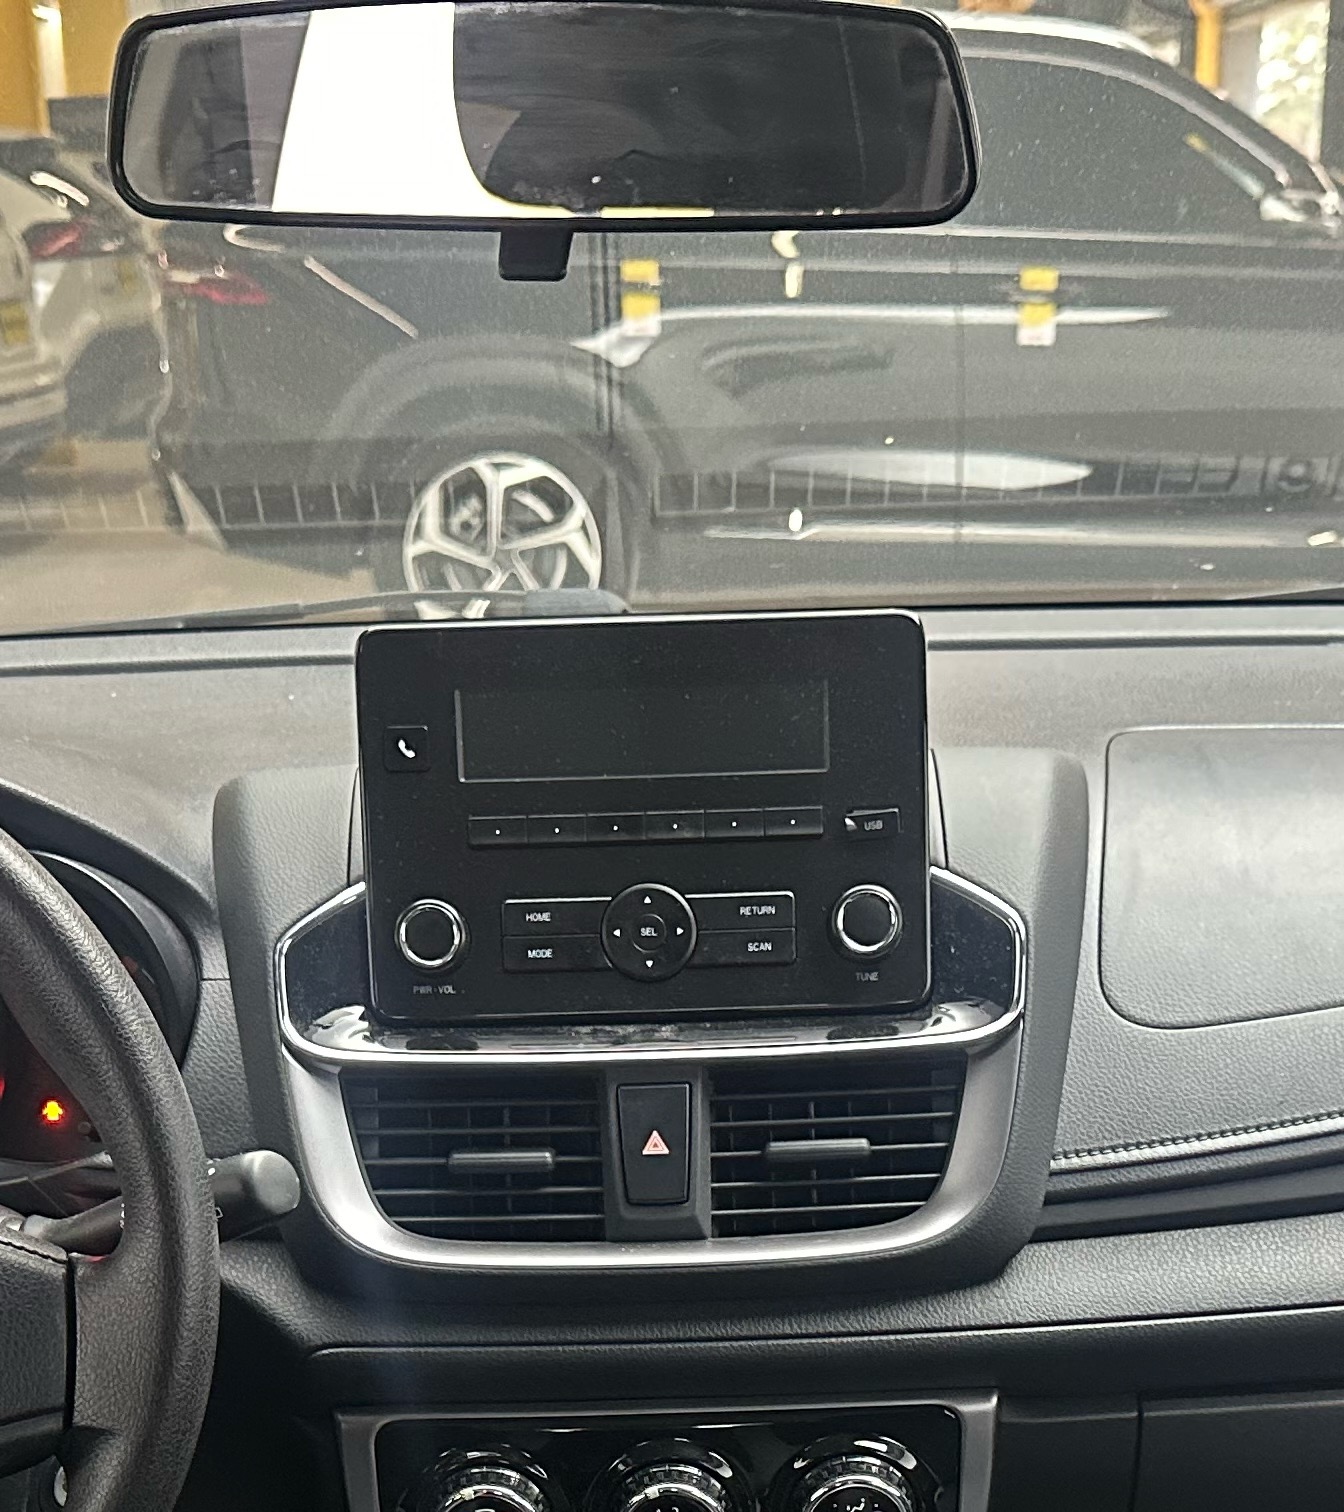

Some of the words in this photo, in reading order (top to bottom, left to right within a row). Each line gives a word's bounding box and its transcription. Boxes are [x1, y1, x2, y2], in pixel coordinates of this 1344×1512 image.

[863, 820, 884, 831] USB
[739, 905, 776, 916] RETURN
[525, 911, 552, 922] HOME
[640, 927, 658, 937] SEL
[747, 942, 772, 952] SCAN
[527, 948, 553, 959] MODE
[855, 971, 879, 982] TUNE
